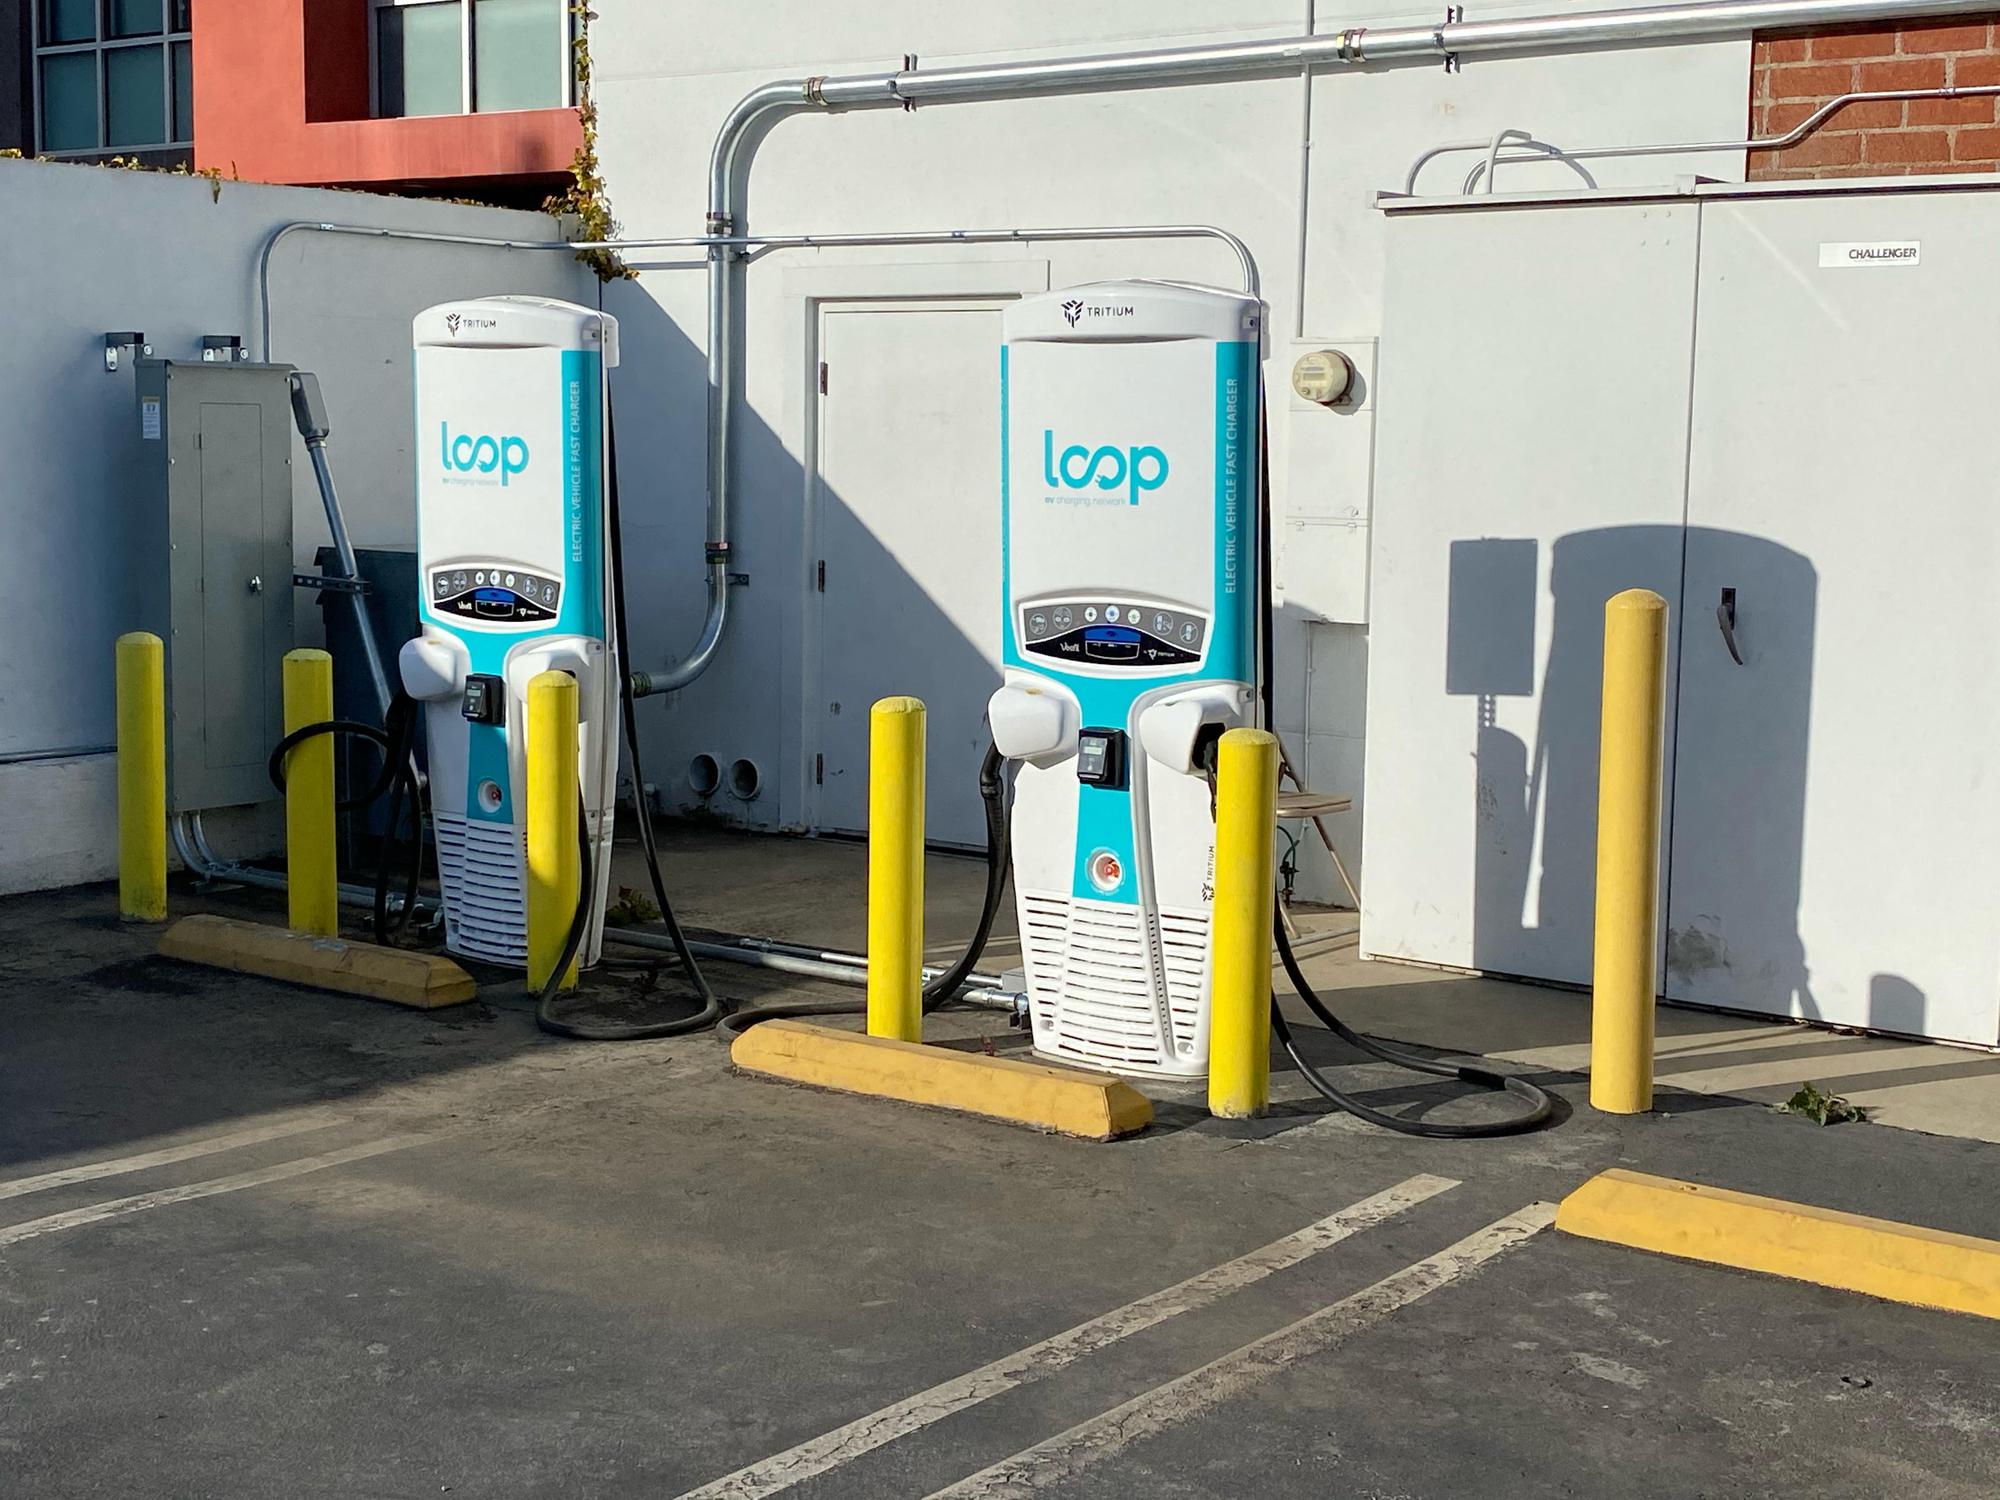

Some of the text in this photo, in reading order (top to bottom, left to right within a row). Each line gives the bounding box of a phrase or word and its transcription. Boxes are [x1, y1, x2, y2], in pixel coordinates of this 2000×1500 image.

[1848, 248, 1917, 259] CHALLENGER
[462, 319, 497, 328] TRITIUM
[1087, 306, 1134, 317] TRITIUM
[441, 421, 530, 487] loop
[570, 381, 582, 562] ELECTRIC VEHICLE FAST CHARGER
[1044, 430, 1170, 506] loop
[1225, 378, 1238, 594] ELECTRIC VEHICLE FAST CHARGER
